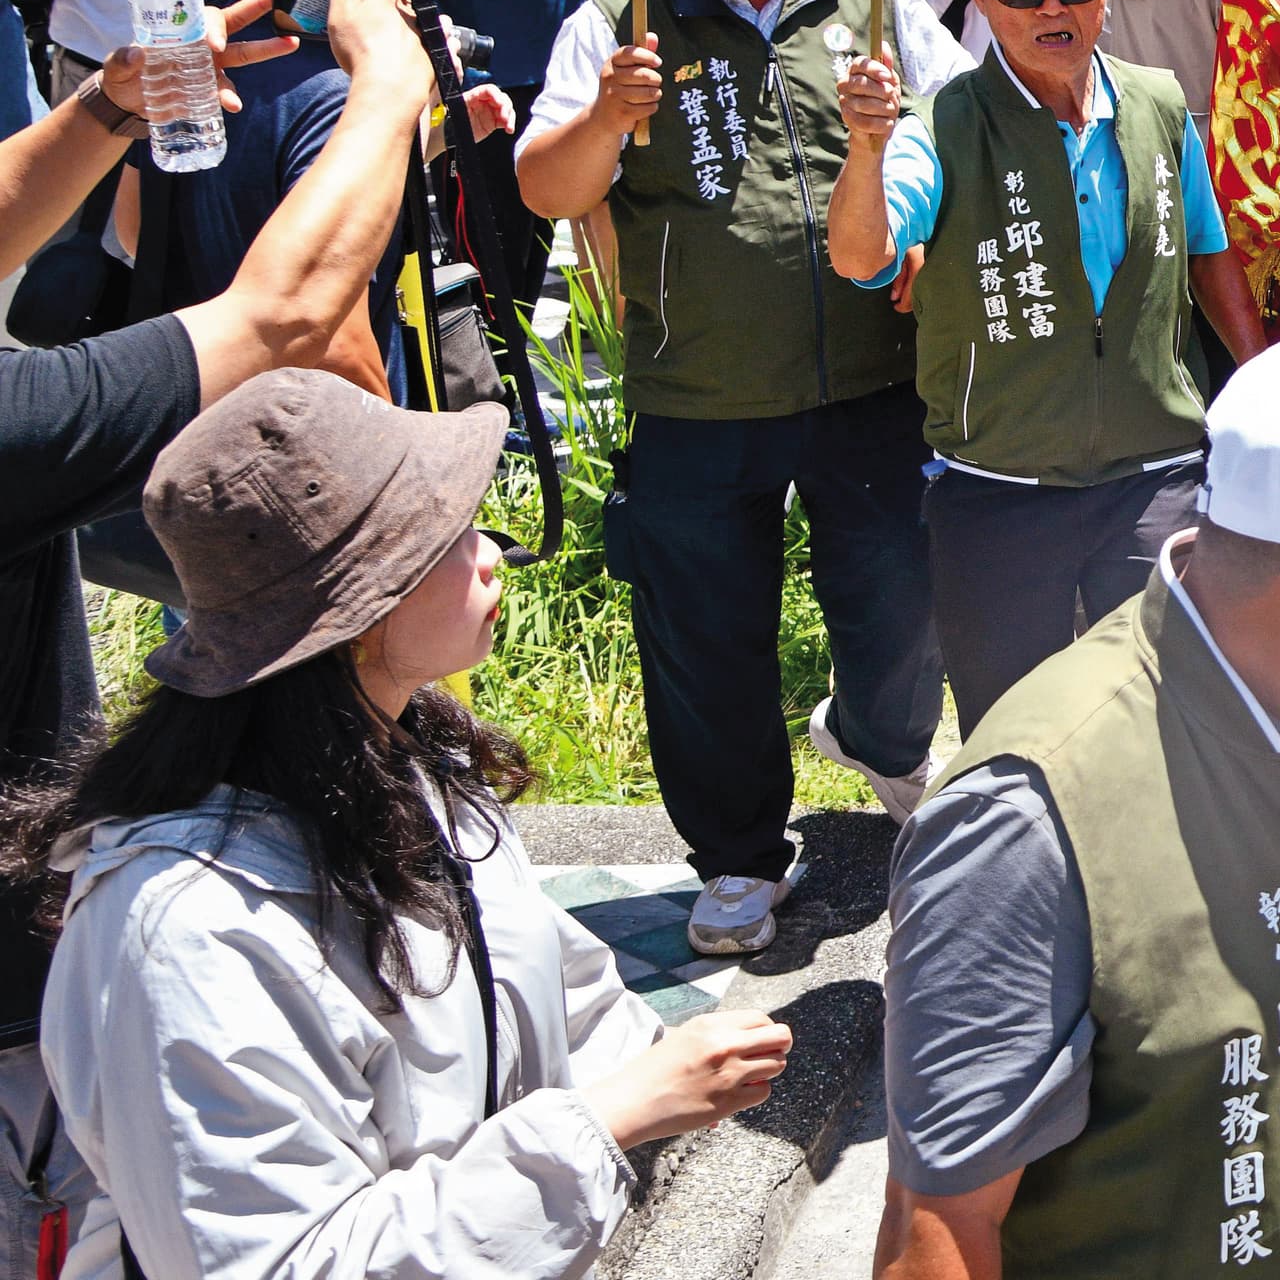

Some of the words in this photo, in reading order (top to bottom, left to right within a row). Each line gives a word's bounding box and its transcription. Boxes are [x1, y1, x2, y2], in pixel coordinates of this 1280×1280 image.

[679, 87, 732, 201] 葉孟家
[707, 56, 751, 162] 執行委員
[976, 237, 1017, 344] 服務團隊
[1220, 1033, 1273, 1266] 服務團隊
